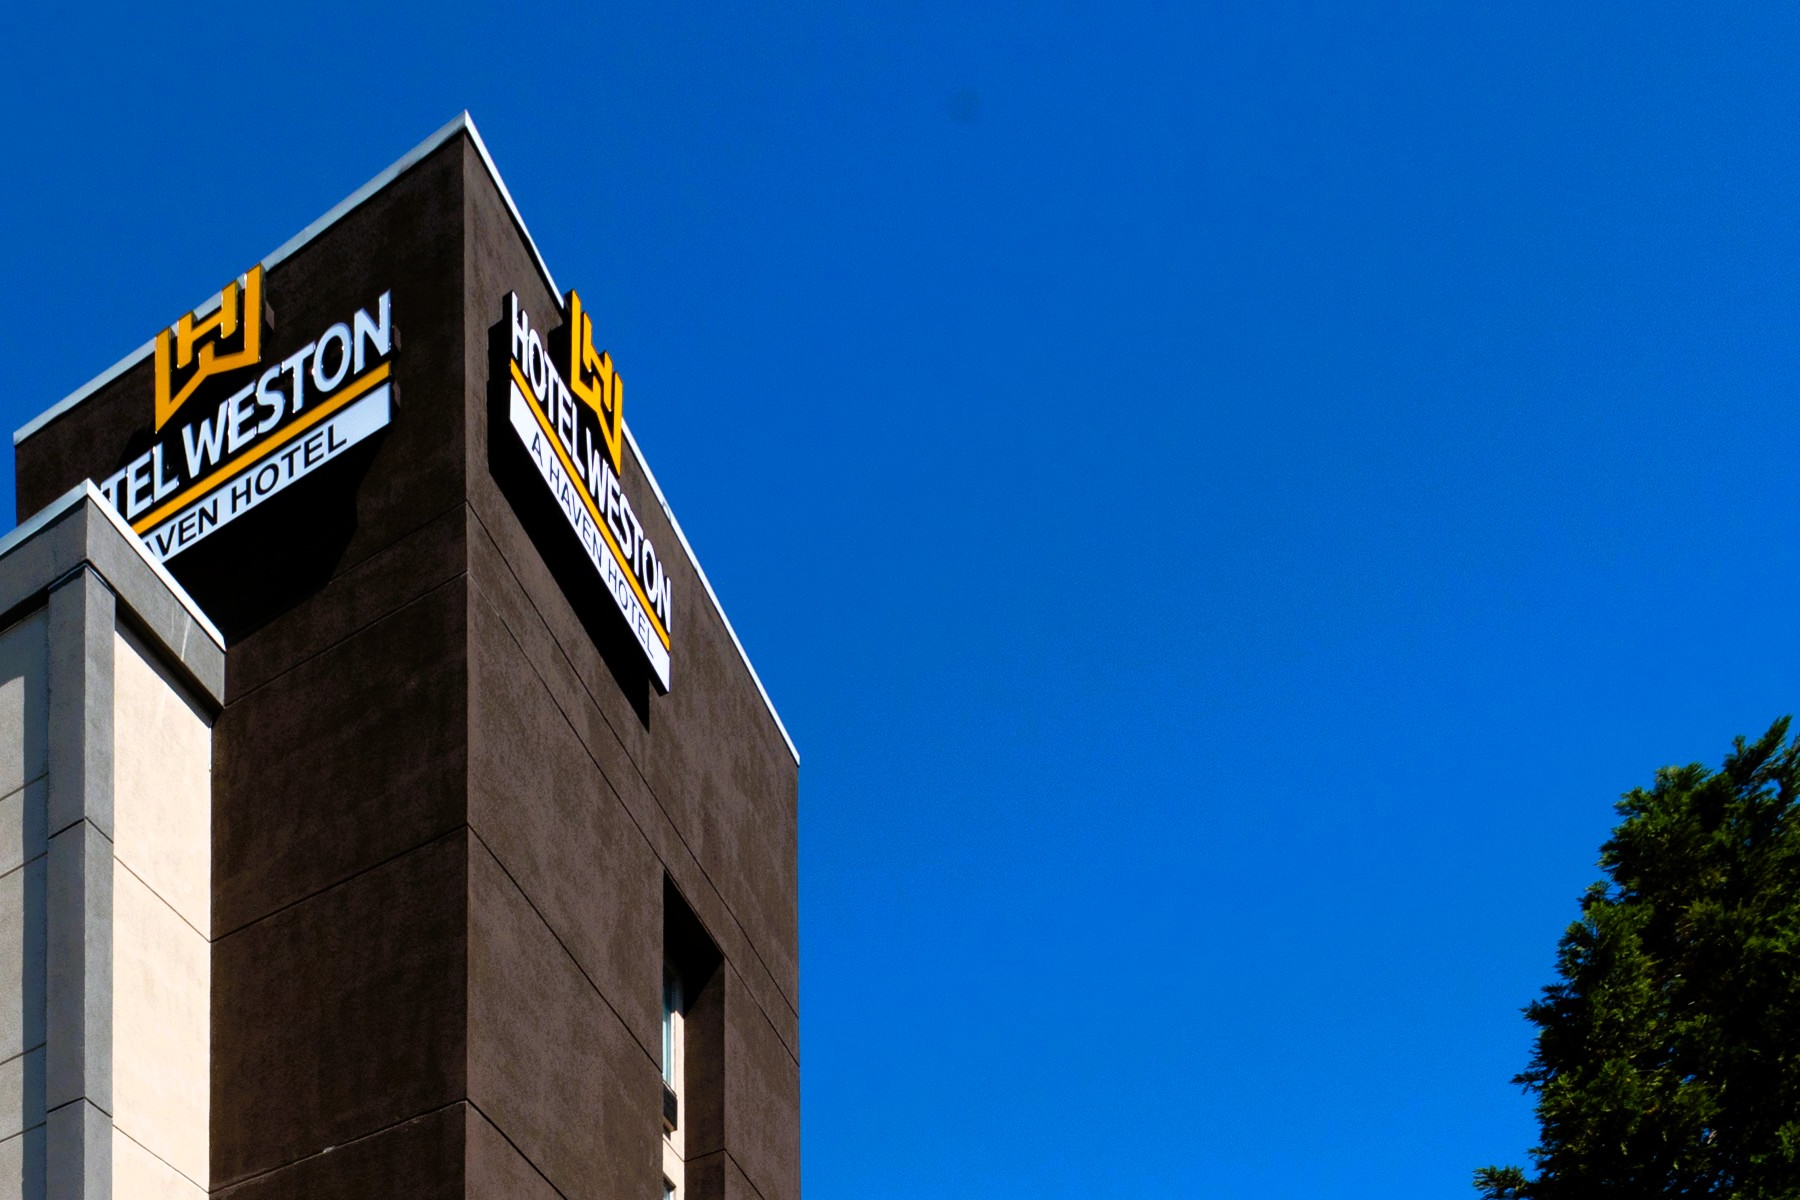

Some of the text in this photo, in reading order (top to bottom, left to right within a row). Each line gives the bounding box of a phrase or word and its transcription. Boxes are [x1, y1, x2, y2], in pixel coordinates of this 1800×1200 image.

[101, 288, 391, 521] TEL WESTON
[231, 423, 348, 515] HOTEL
[512, 290, 671, 634] HOTEL WESTON
[531, 431, 654, 659] A HAVEN HOTEL
